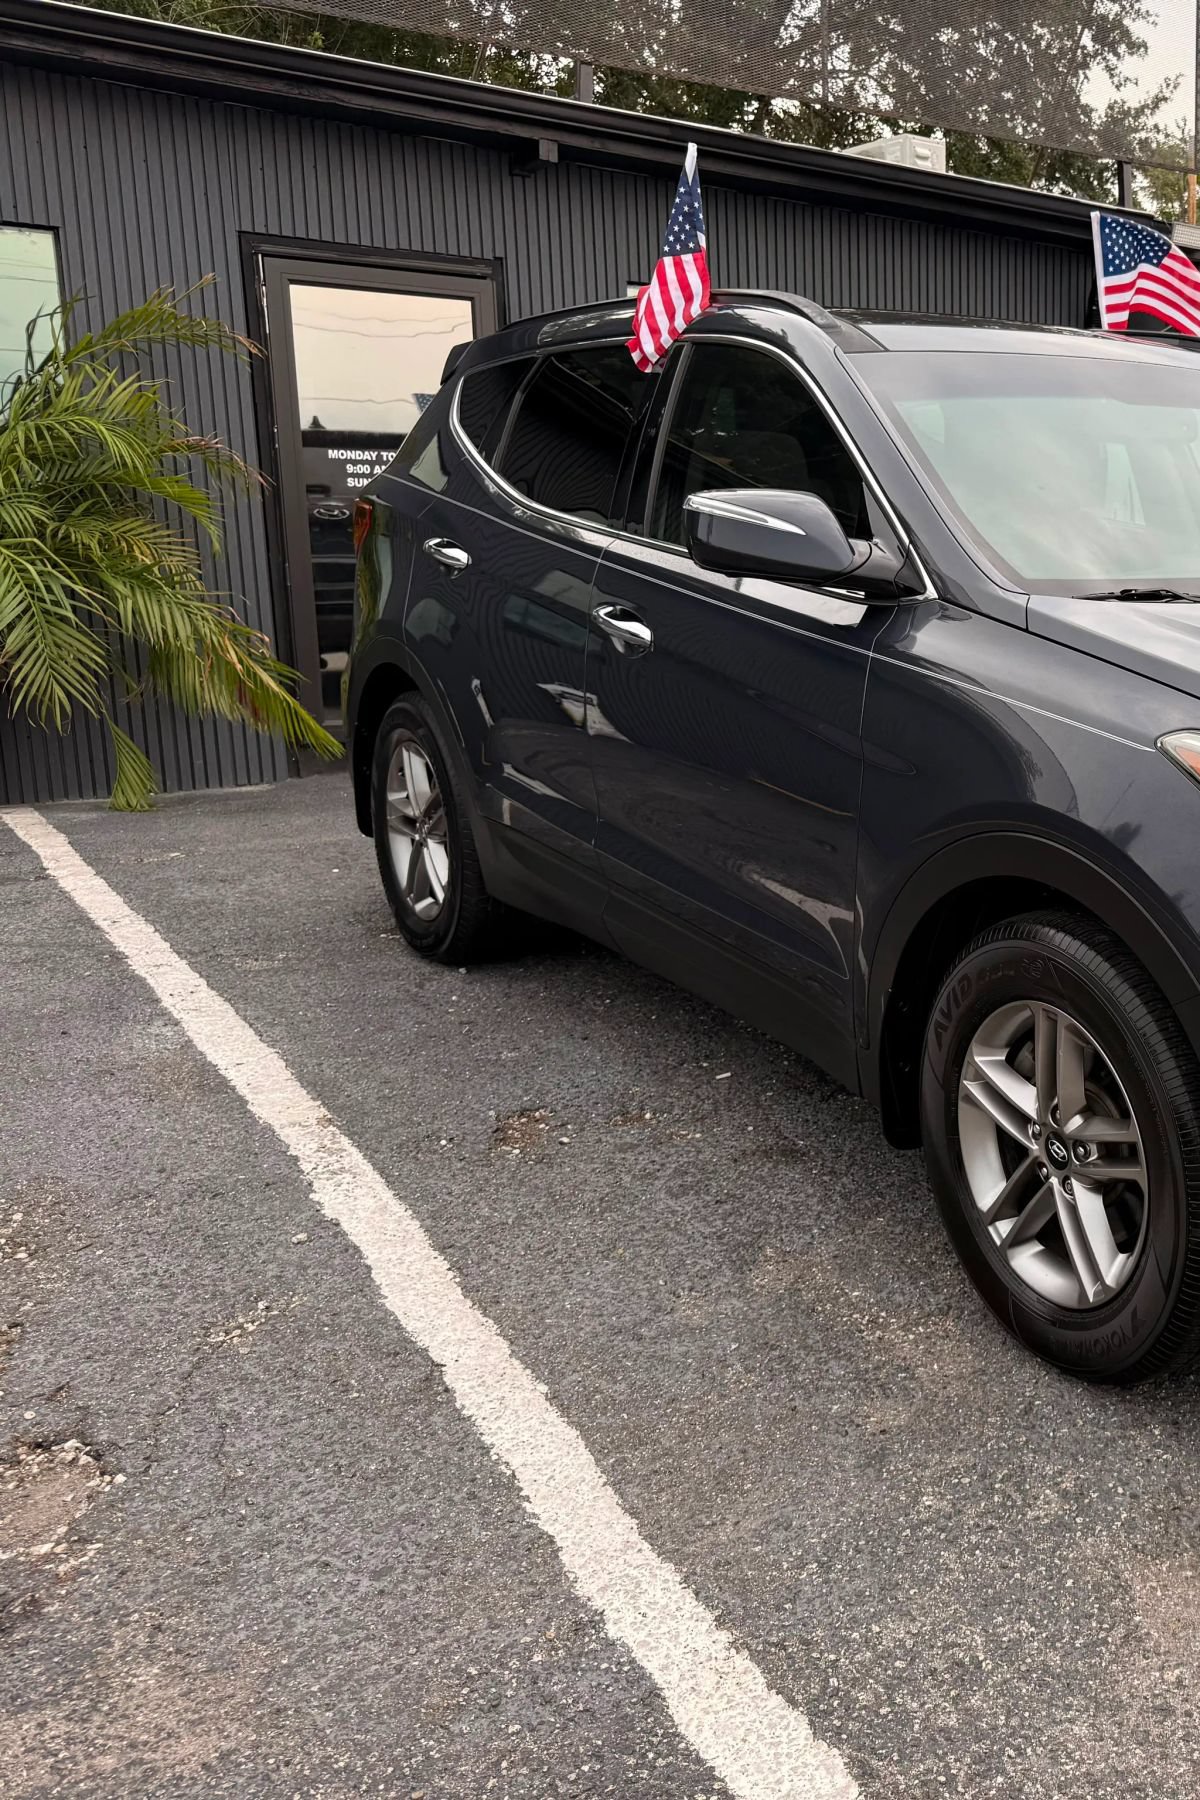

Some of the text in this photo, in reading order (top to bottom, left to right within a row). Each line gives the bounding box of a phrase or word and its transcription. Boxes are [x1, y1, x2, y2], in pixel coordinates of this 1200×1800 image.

[328, 450, 396, 461] MONDAY TO
[346, 463, 371, 474] 9:00
